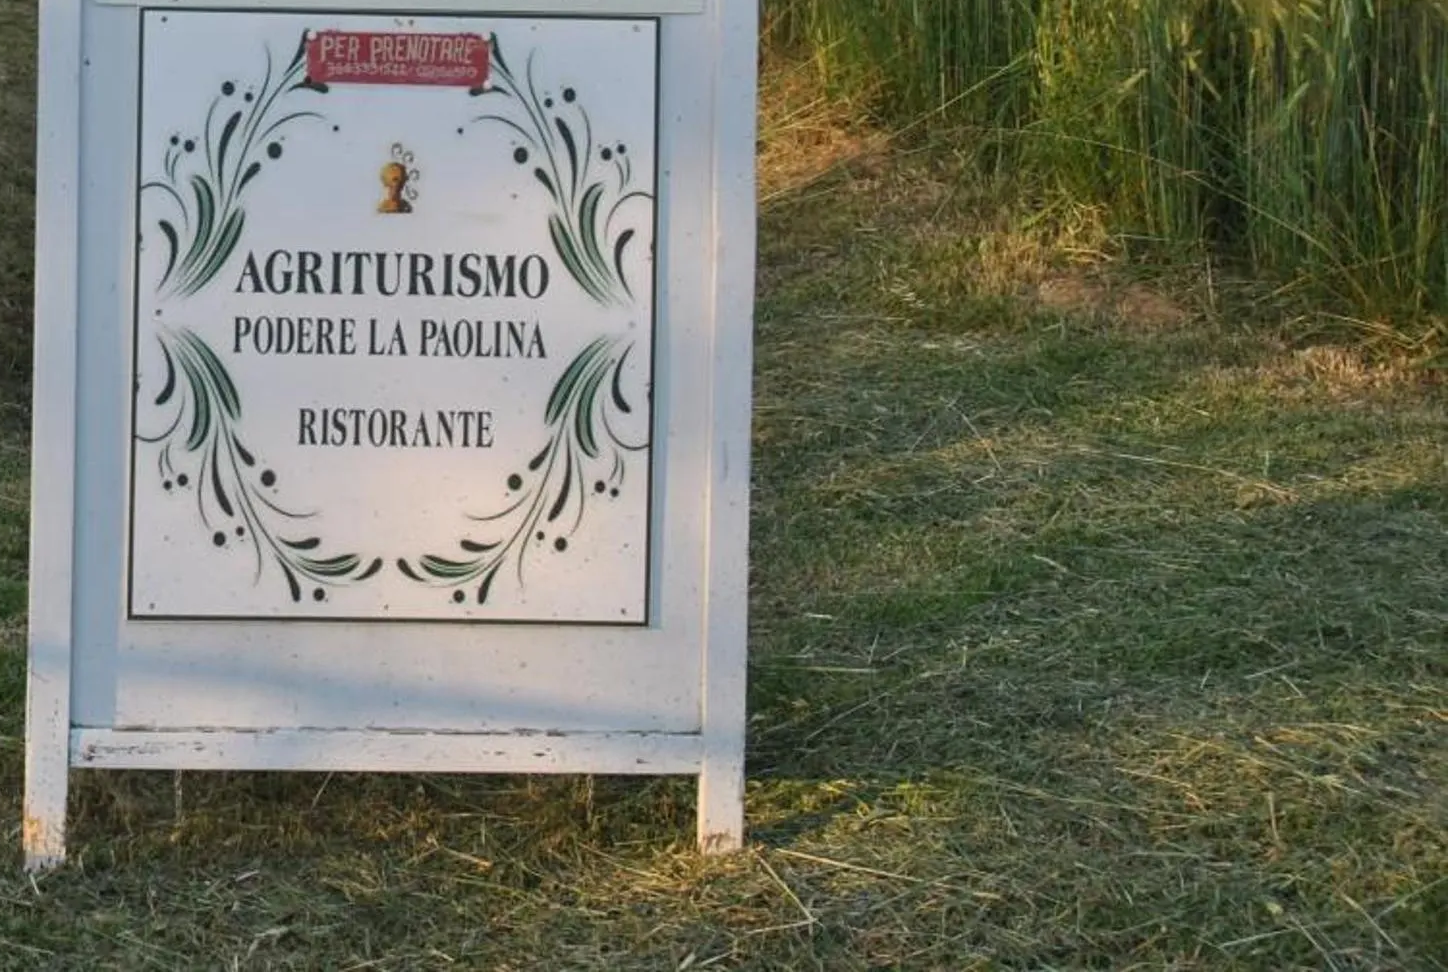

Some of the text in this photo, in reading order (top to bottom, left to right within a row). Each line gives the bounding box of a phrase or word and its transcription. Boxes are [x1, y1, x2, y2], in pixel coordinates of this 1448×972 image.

[319, 34, 476, 64] PER PRENOTARE
[234, 249, 550, 299] AGRITURISMO
[232, 315, 548, 359] PODERE LA PAOLINA
[297, 408, 494, 448] RISTORANTE
